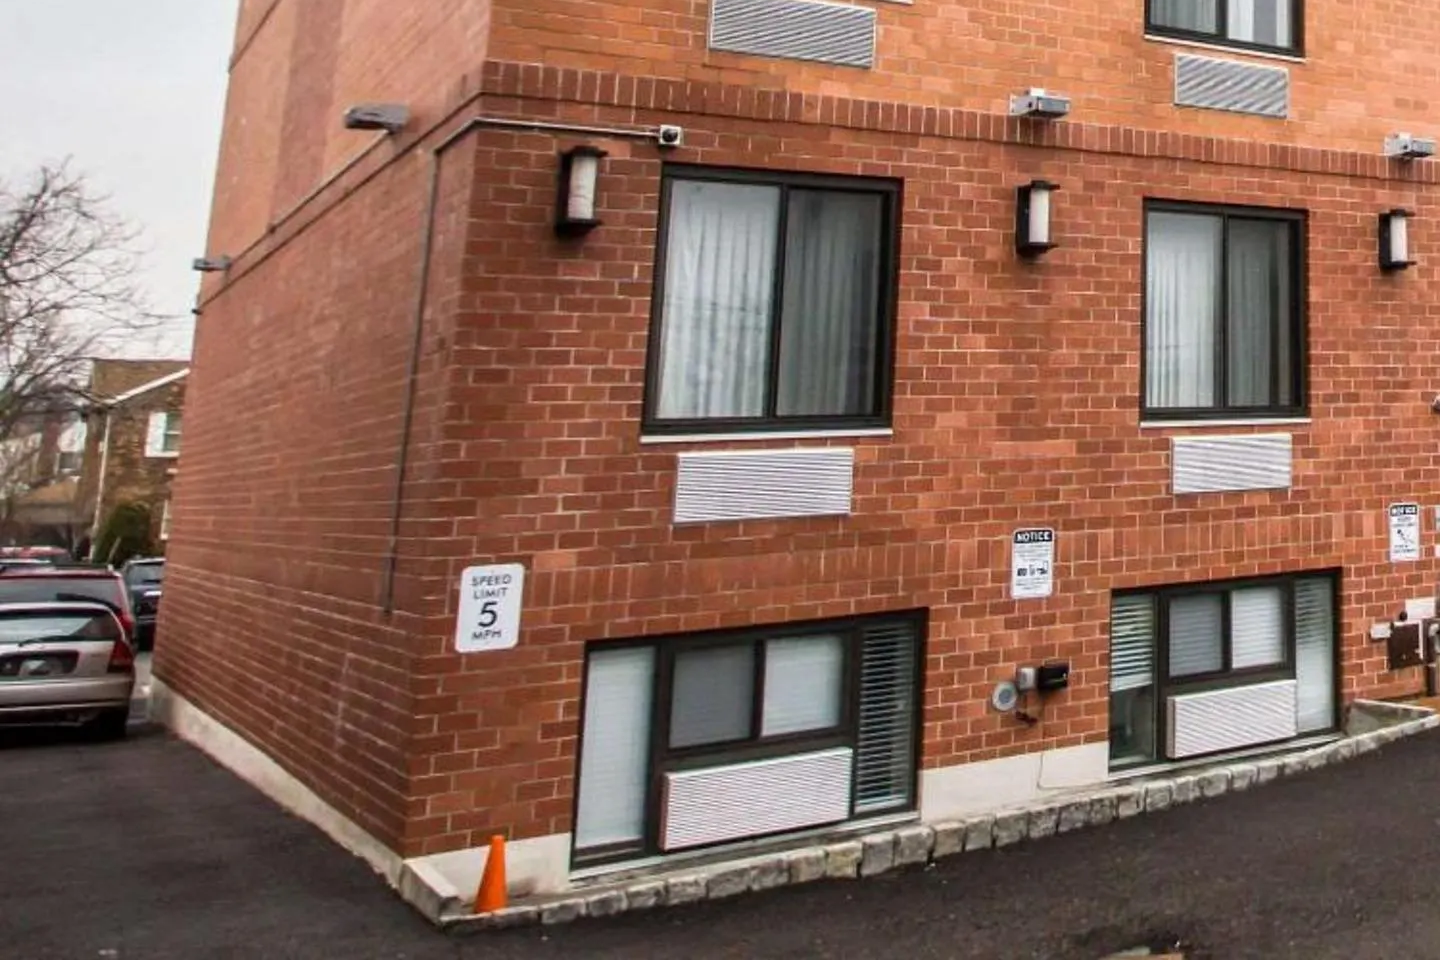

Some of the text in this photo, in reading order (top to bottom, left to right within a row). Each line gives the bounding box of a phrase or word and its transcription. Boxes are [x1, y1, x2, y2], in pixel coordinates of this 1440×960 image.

[1016, 531, 1051, 542] NOTICE
[471, 573, 512, 587] SPEED
[473, 587, 509, 600] LIMIT
[478, 601, 498, 628] 5
[471, 630, 502, 641] MPH
